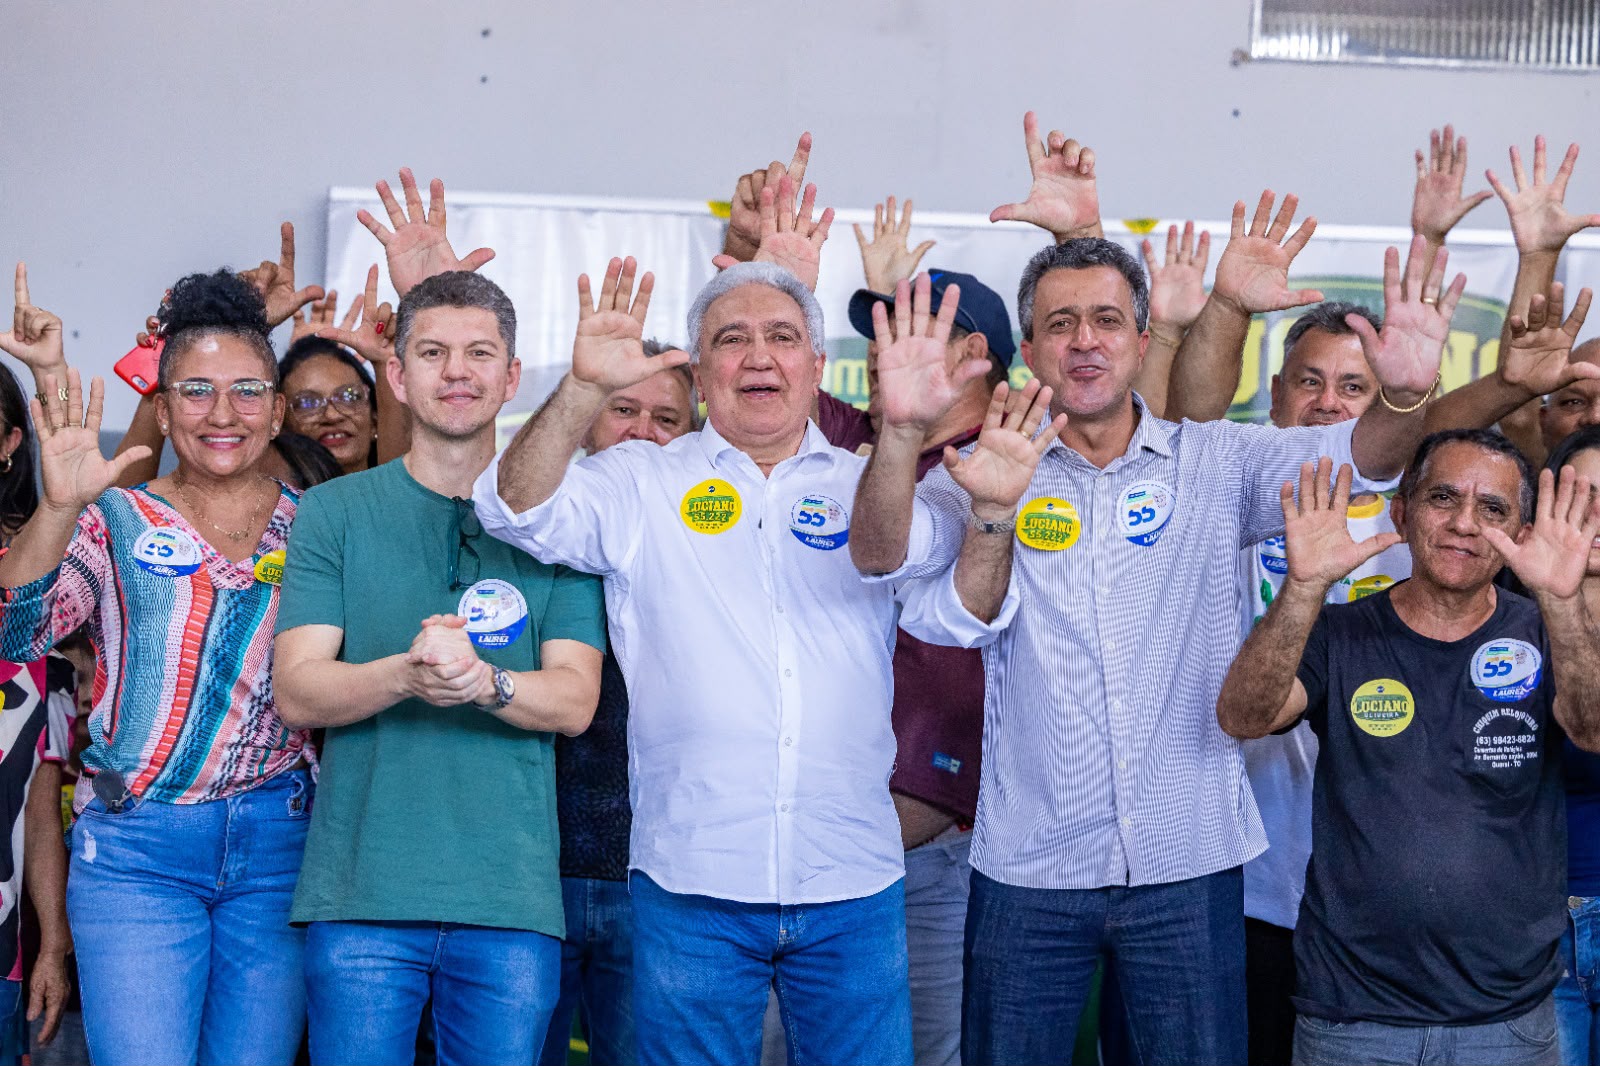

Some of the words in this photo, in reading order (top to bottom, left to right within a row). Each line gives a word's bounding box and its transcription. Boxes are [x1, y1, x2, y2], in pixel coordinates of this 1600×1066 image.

[798, 511, 826, 527] 55
[1128, 506, 1156, 526] 55
[1021, 518, 1075, 533] LUCIANO
[1483, 660, 1513, 678] 55
[1352, 700, 1409, 713] LUCIANO
[1473, 708, 1500, 733] CHIQUIM
